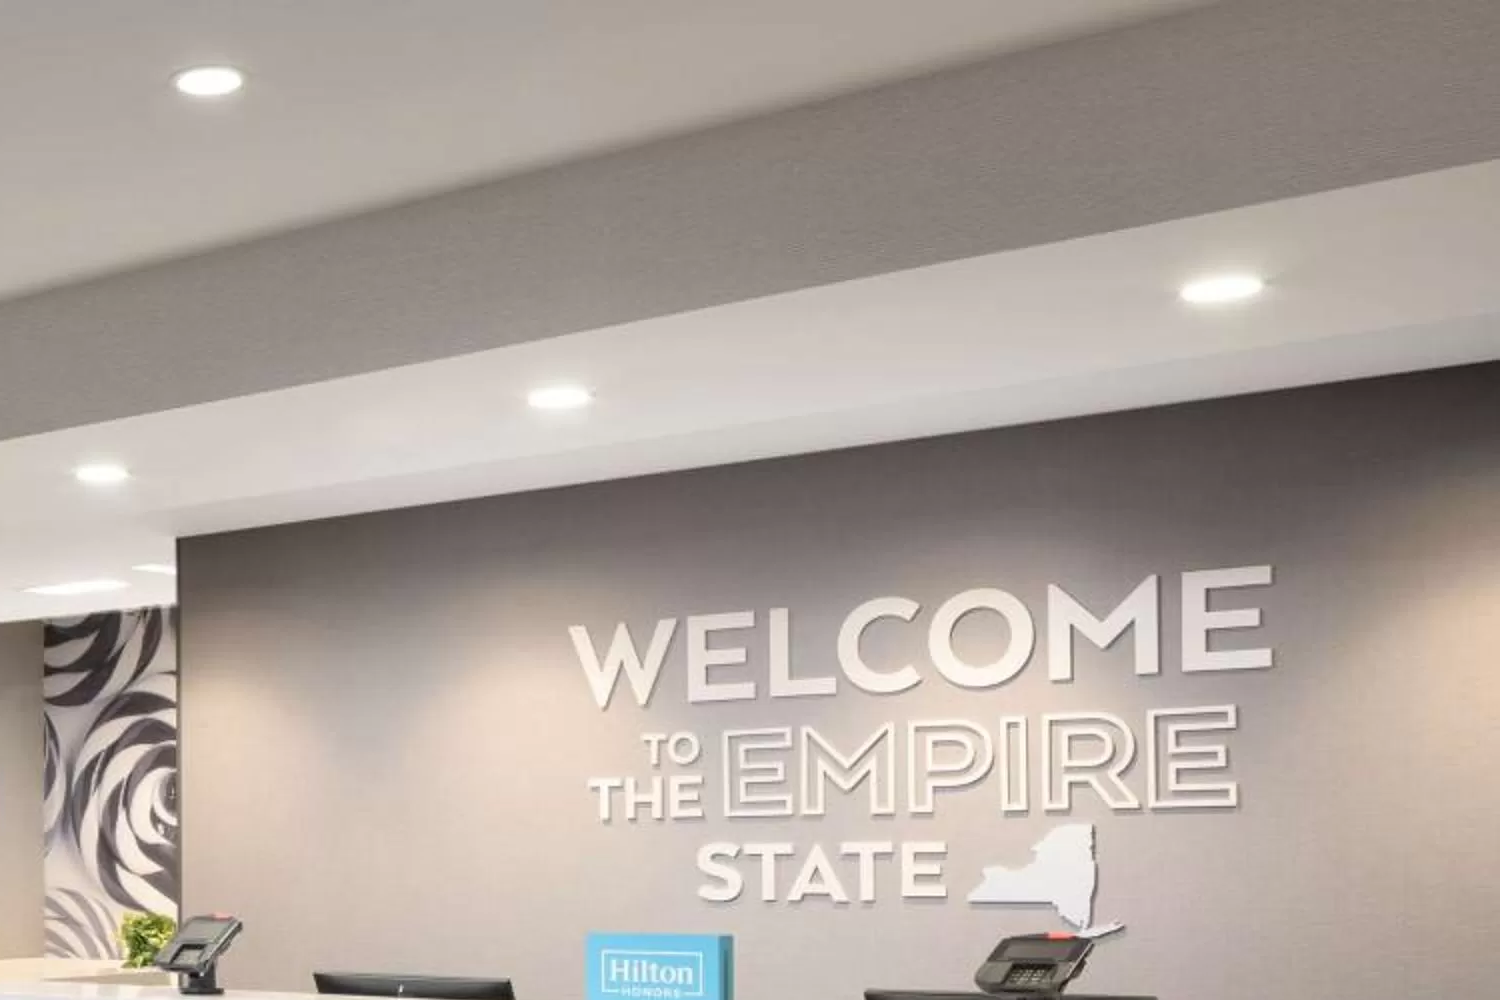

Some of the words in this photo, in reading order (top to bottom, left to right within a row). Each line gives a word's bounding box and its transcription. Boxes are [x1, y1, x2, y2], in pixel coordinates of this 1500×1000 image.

[567, 564, 1275, 710] WELCOME
[588, 774, 704, 821] THE
[723, 704, 1239, 819] EMPIRE
[642, 732, 701, 767] TO
[697, 841, 948, 903] STATE
[610, 958, 693, 984] Hilton
[621, 986, 681, 998] HONORS
